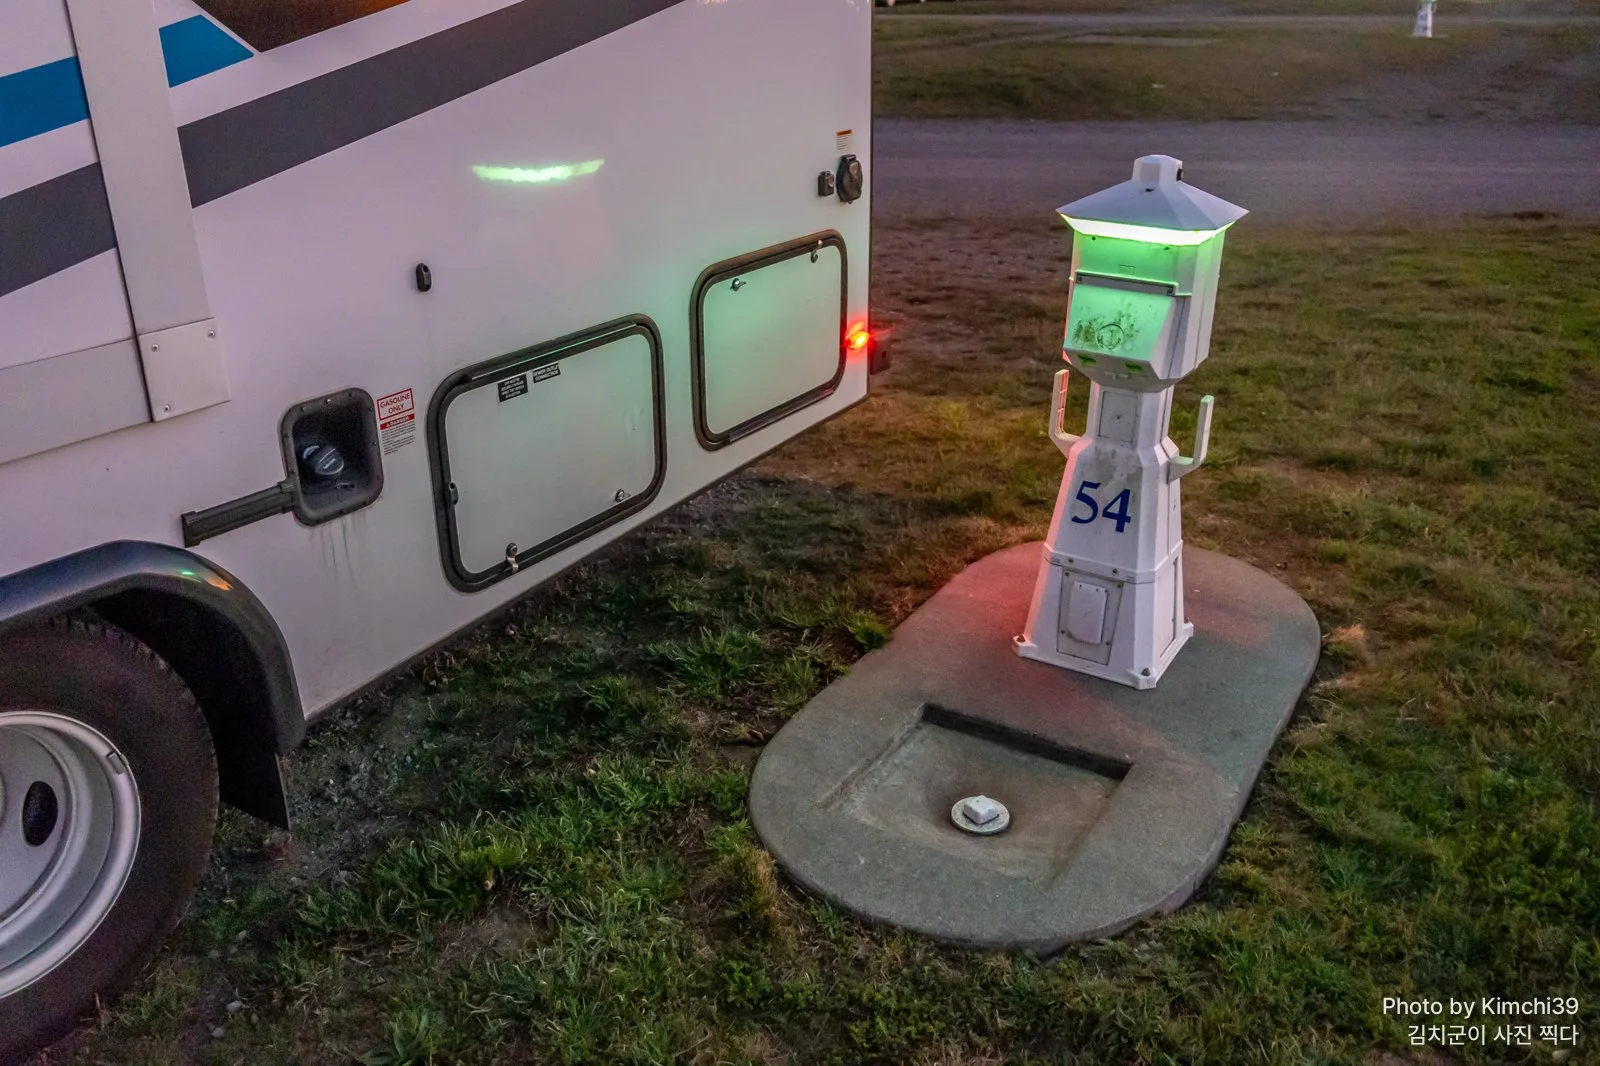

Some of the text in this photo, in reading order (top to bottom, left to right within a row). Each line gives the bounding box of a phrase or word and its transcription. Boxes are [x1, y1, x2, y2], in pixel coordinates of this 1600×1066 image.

[380, 392, 411, 409] GASOLINE
[388, 403, 405, 414] ONLY
[1071, 480, 1132, 533] 54
